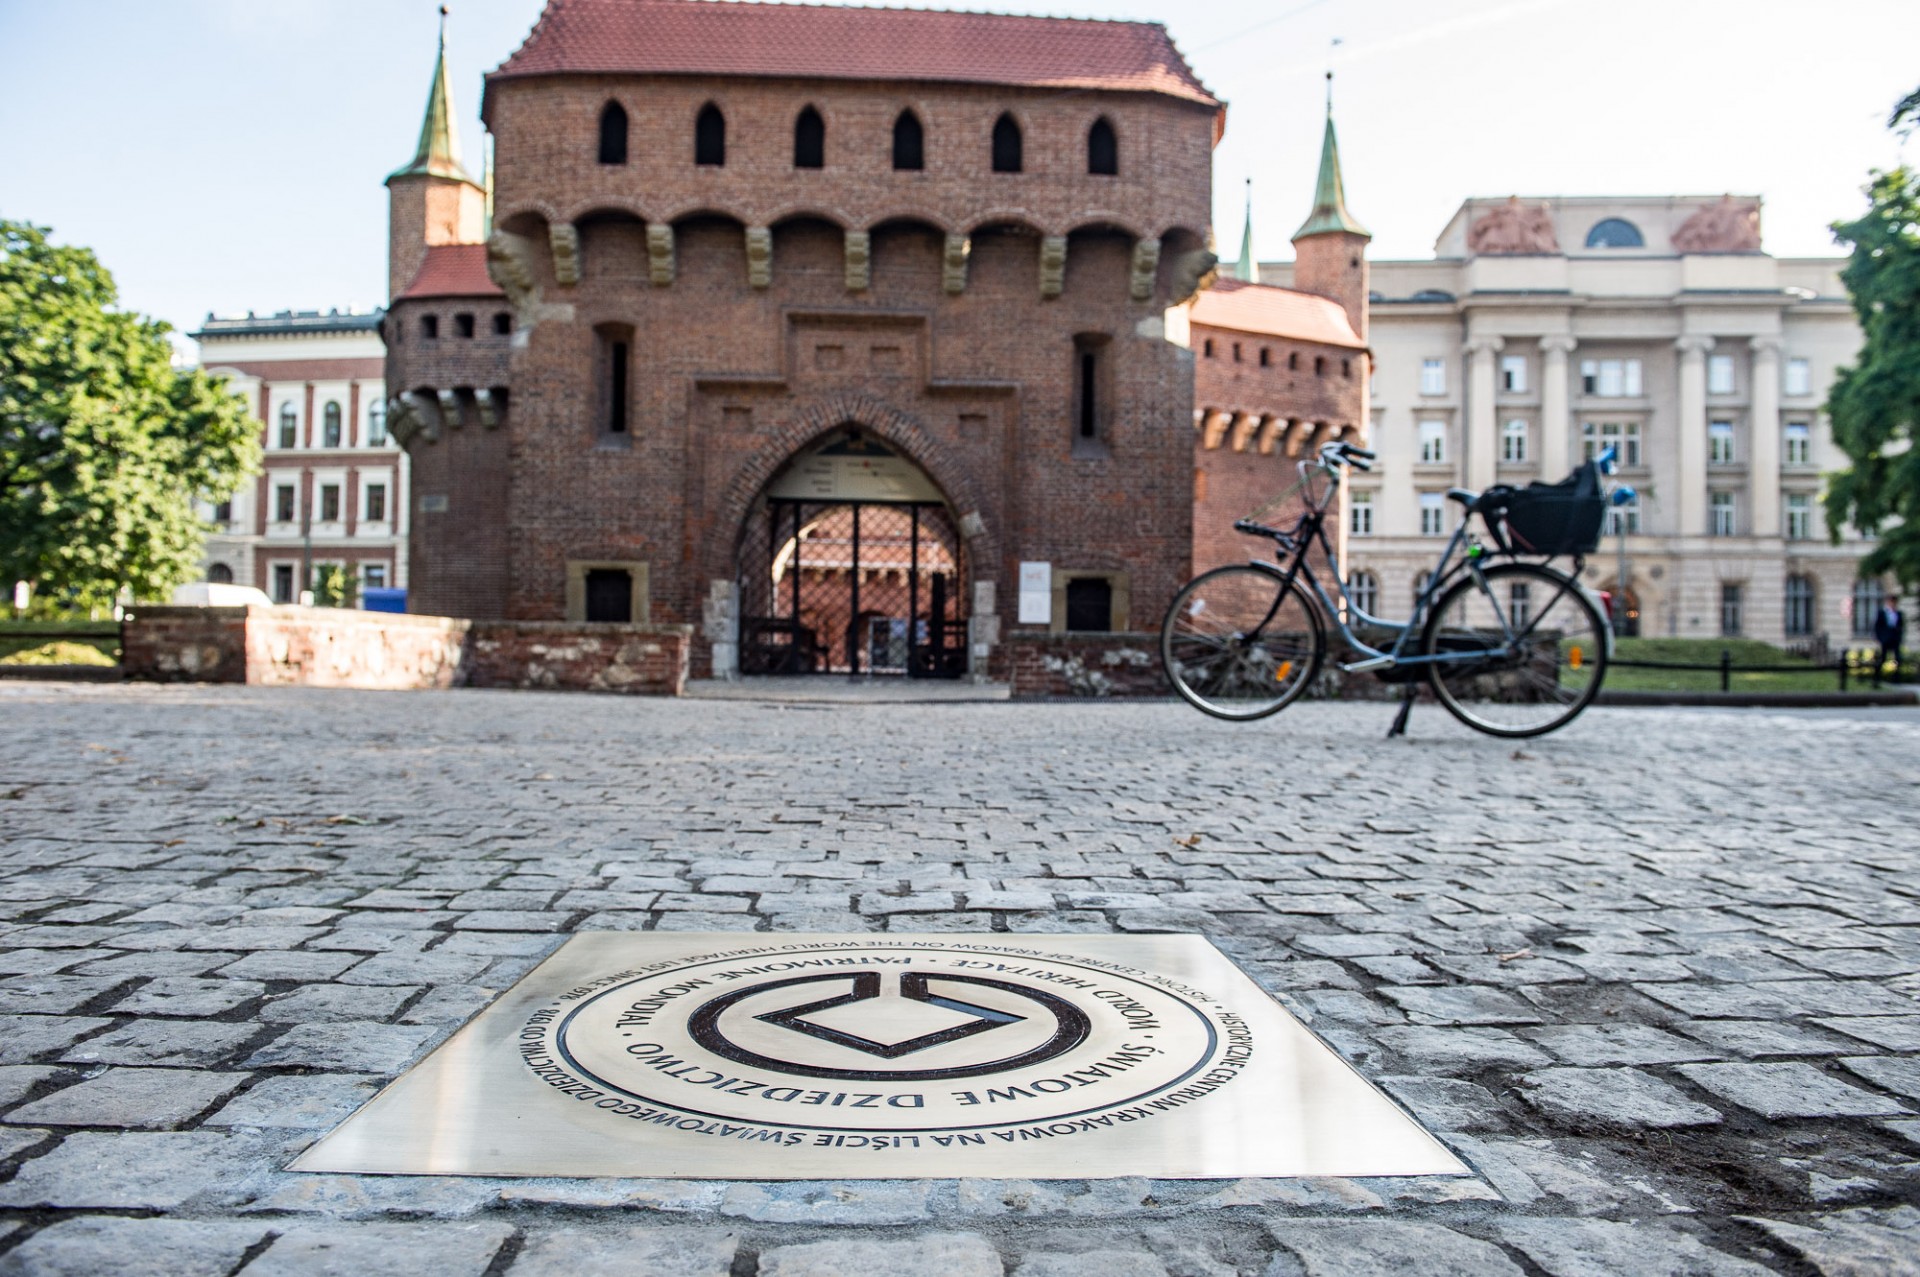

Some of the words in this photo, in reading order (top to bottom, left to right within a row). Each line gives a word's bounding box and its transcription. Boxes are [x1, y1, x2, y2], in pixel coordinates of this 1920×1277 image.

[679, 947, 777, 963] HERITAGE
[782, 942, 860, 950] WORLD
[588, 969, 643, 987] SINCE
[641, 960, 680, 972] LIST
[711, 957, 912, 981] PATRIMOINE
[949, 959, 1097, 989] HERITAGE
[1076, 957, 1146, 976] CENTRE
[559, 986, 598, 1000] 1978
[615, 978, 713, 1029] MONDIAL
[526, 1009, 561, 1025] 1978
[1092, 990, 1161, 1030] WORLD
[519, 1026, 547, 1040] OD
[1215, 1012, 1253, 1069] HISTORYCZNE
[519, 1040, 605, 1101] DZIEDZICTWA
[626, 1043, 924, 1108] DZIEDZICTWO
[951, 1043, 1165, 1106] ŚWIATOWE
[1145, 1068, 1239, 1111] CENTRUM
[594, 1098, 807, 1147] ŚWIATOWEGO
[991, 1107, 1154, 1143] KRAKOWA
[813, 1134, 920, 1151] LIŚCIE
[930, 1133, 986, 1147] NA
